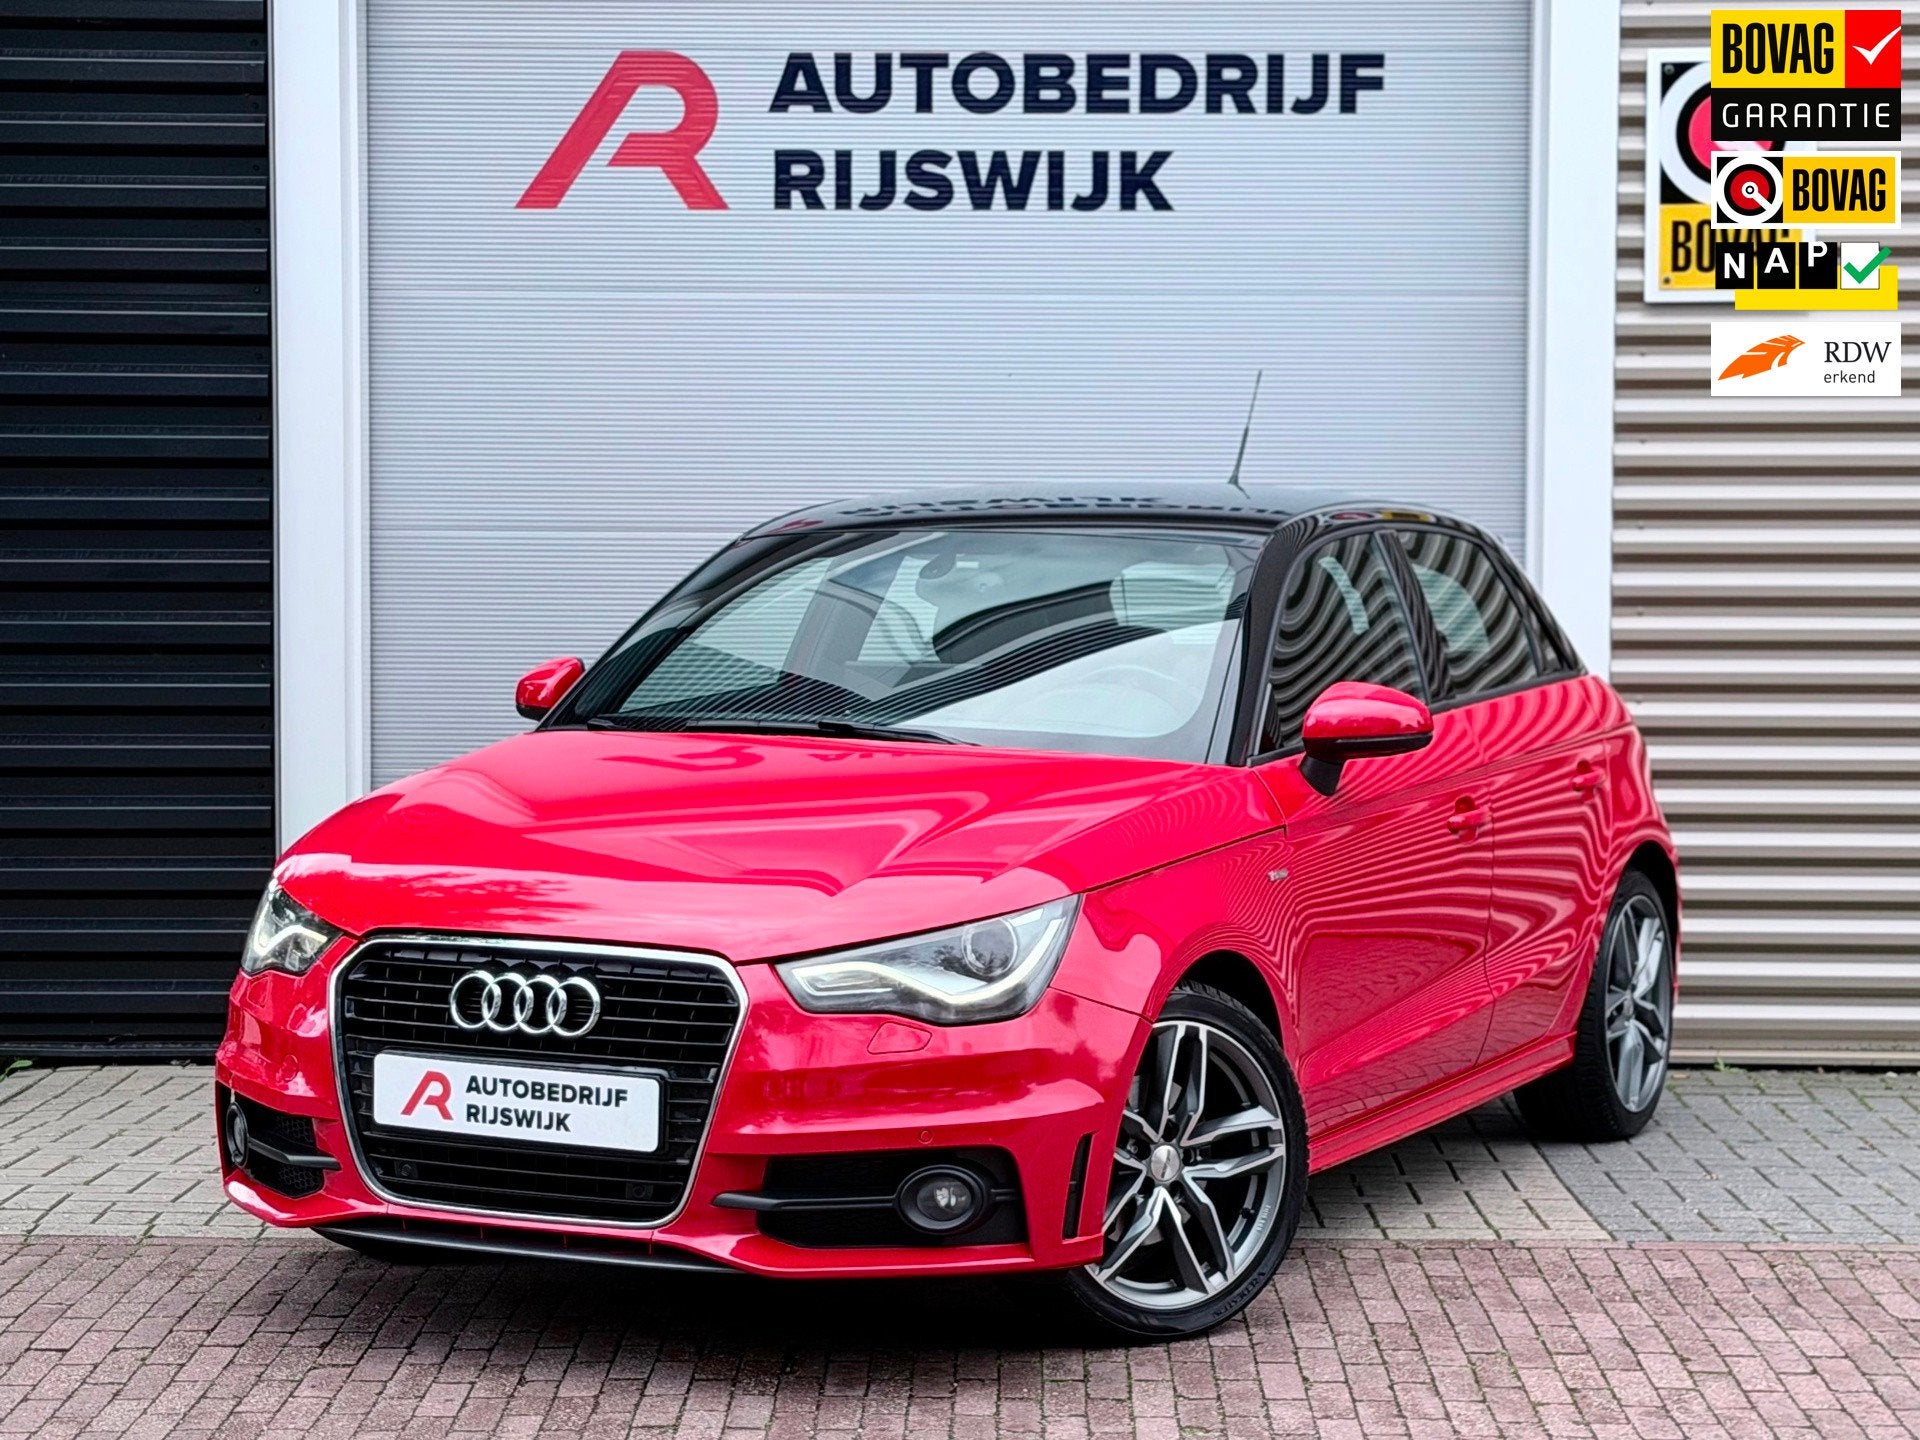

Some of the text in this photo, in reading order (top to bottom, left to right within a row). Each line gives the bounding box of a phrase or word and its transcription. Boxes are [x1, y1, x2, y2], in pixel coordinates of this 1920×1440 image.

[769, 53, 1386, 115] AUTOBEDRIJF
[774, 150, 1174, 212] RIJSWIJK
[465, 1074, 629, 1108] AUTOBEDRIJF
[465, 1103, 572, 1133] RIJSWIJK
